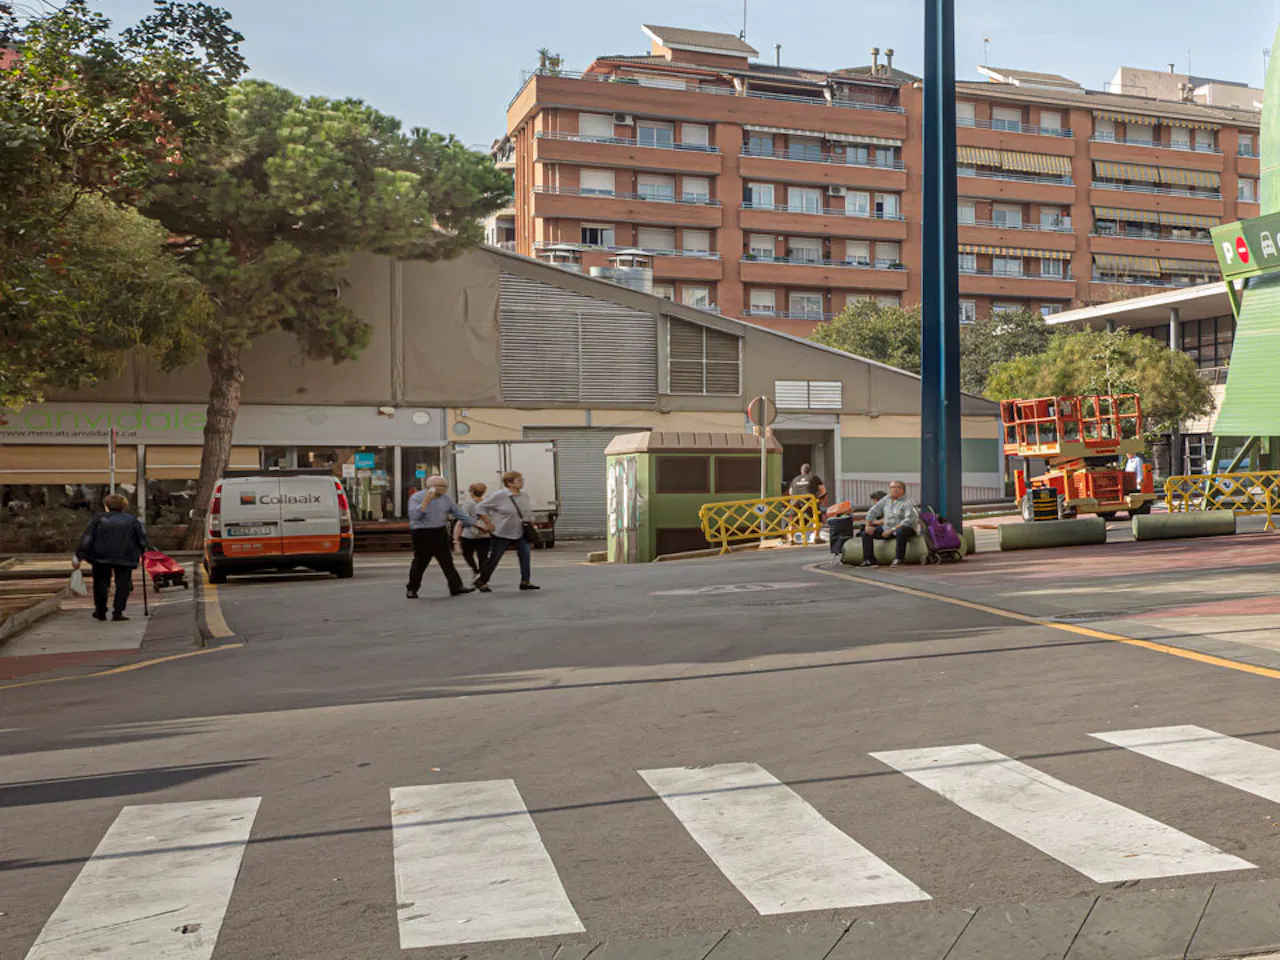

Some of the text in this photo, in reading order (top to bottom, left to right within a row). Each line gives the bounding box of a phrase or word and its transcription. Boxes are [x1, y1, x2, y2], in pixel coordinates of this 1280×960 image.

[1222, 241, 1235, 265] P
[0, 407, 207, 432] canvidale
[0, 430, 137, 438] www.mercatcanvidalt.cat
